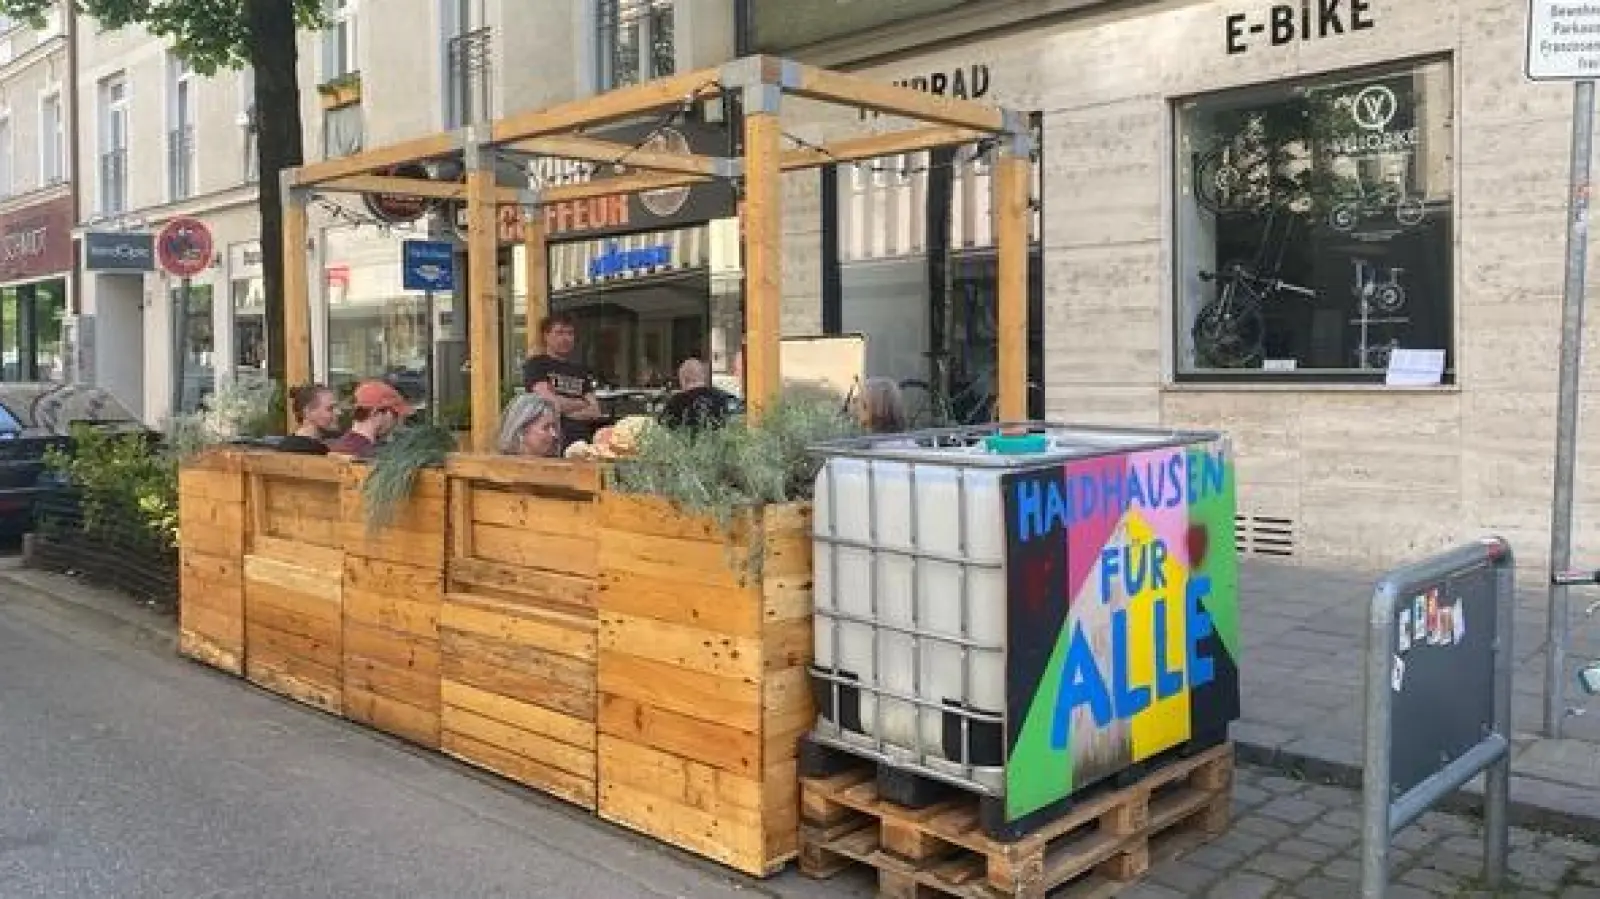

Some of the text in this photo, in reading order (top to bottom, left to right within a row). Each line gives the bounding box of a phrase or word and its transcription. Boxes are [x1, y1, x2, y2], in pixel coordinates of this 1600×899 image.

[1226, 0, 1375, 54] E-BIKE
[1017, 451, 1225, 541] HAIDHAUSEN
[1100, 538, 1168, 604] FÜR
[1051, 576, 1215, 749] ALLE
